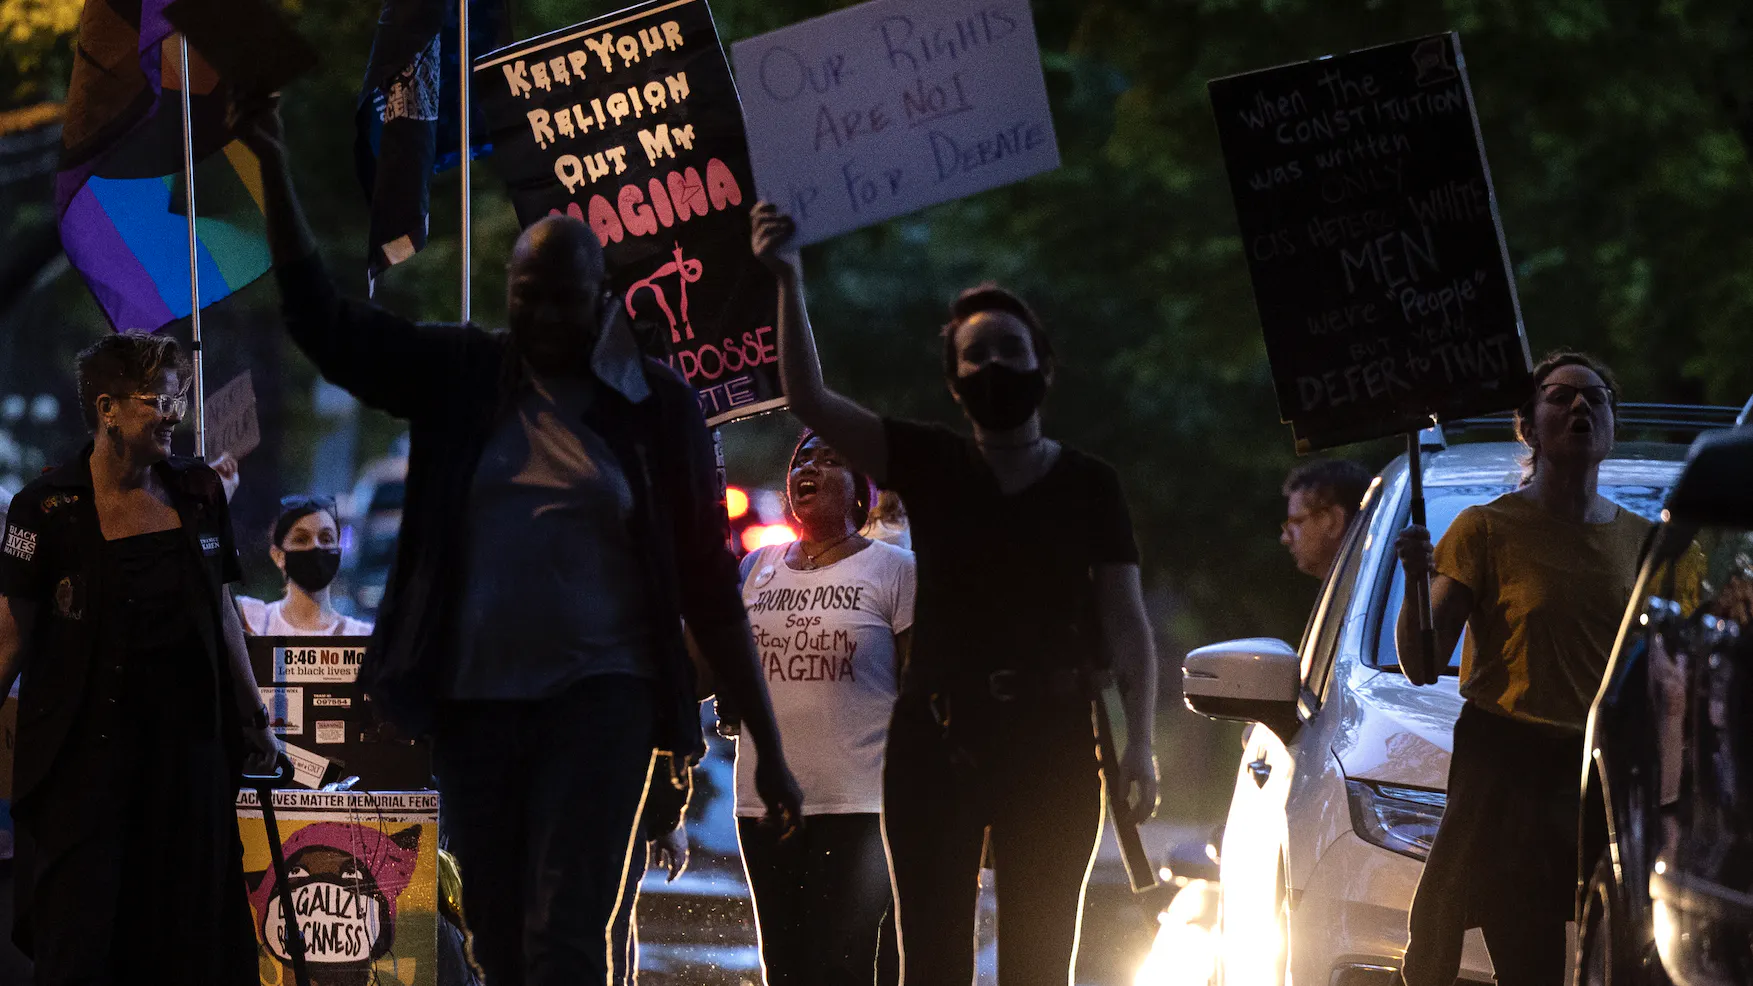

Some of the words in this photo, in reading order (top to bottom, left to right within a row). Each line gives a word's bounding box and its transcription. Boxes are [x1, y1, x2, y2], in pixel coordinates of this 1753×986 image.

[502, 50, 588, 99] KEEP
[584, 20, 685, 73] YOUR
[526, 71, 691, 150] RELIGION
[902, 71, 973, 122] NOT
[1275, 84, 1469, 145] CONSTITUTION
[554, 145, 627, 195] OUT
[637, 123, 697, 168] MY
[1249, 160, 1303, 192] was
[1315, 129, 1411, 170] written
[1321, 158, 1405, 204] ONLY
[1253, 228, 1296, 261] CIS
[1408, 177, 1486, 223] WHITE
[1340, 224, 1442, 295] MEN
[1307, 301, 1377, 335] were
[678, 325, 778, 383] POSSE
[1350, 336, 1390, 362] BUT
[1296, 357, 1413, 412] DEFER
[1405, 348, 1431, 375] to
[1431, 333, 1510, 384] THAT
[3, 546, 32, 562] MATTER
[6, 535, 36, 553] LIVES
[9, 525, 37, 542] BLACK
[810, 585, 864, 612] POSSE
[786, 614, 821, 630] Says
[284, 650, 316, 665] 8:46
[320, 650, 340, 665] No
[751, 625, 791, 656] Stay
[796, 629, 830, 651] Out
[834, 629, 857, 661] My
[278, 667, 296, 676] Let
[297, 666, 325, 676] black
[327, 666, 351, 676] lives
[272, 794, 296, 806] IVES
[300, 794, 344, 807] MATTER
[348, 795, 406, 808] MEMORIAL
[409, 796, 437, 808] FENC
